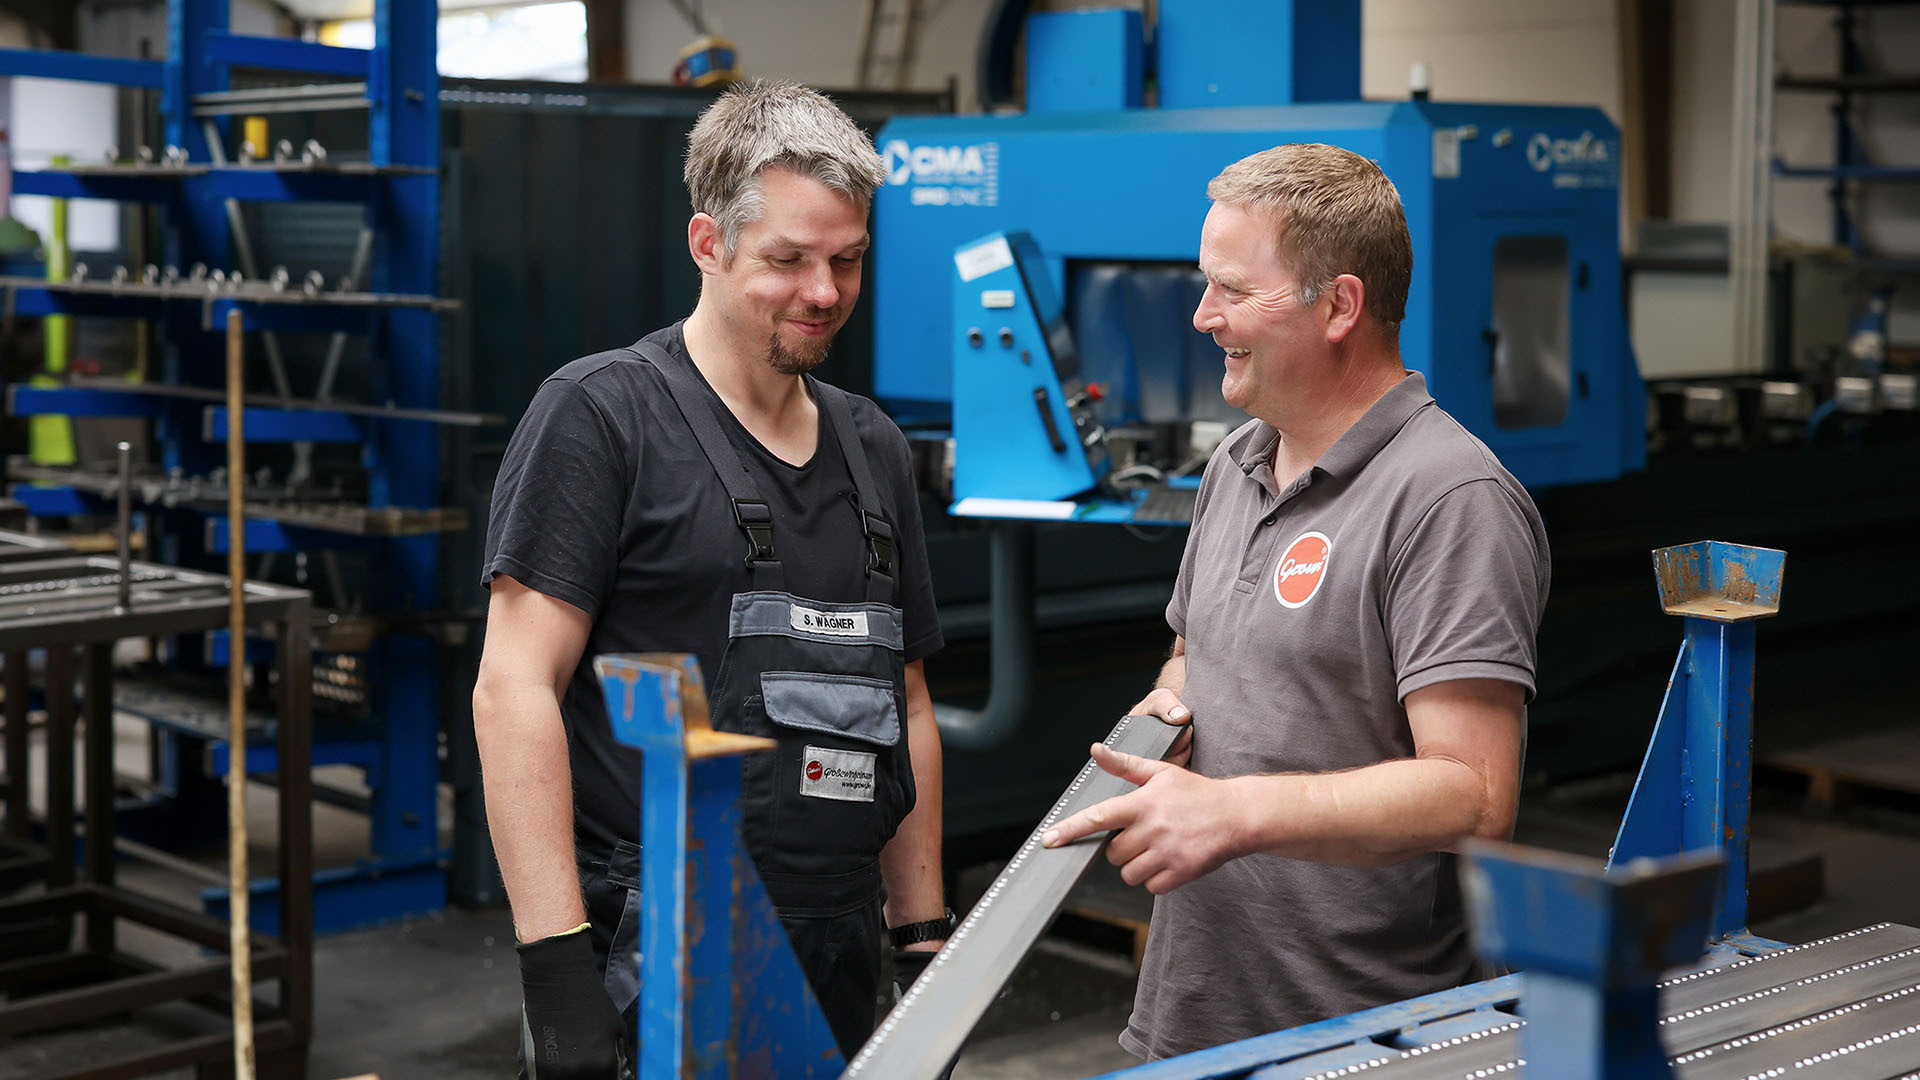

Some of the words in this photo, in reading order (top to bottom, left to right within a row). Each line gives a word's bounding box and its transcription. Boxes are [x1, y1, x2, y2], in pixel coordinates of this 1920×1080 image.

[911, 145, 984, 175] CMA
[804, 614, 814, 626] S.
[815, 615, 855, 630] WAGNER
